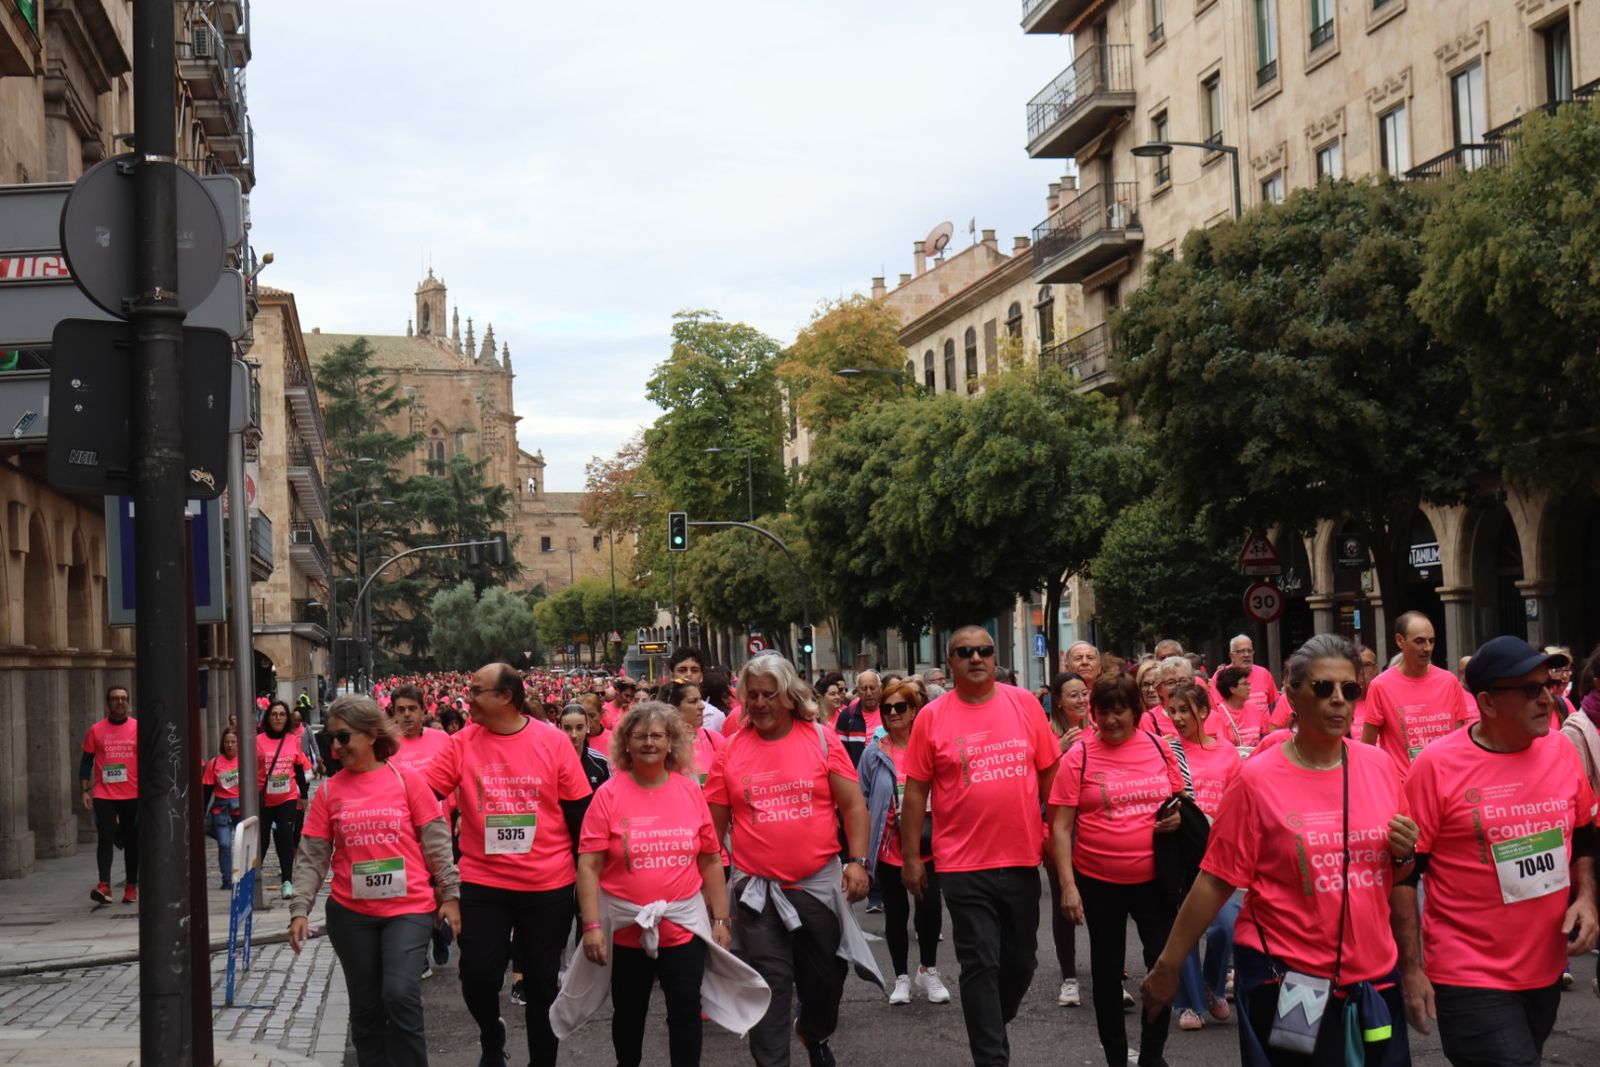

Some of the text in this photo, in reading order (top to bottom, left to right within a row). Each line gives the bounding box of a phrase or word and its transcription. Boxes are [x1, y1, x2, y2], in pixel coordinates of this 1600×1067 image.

[1252, 595, 1275, 609] 30
[1405, 711, 1451, 724] En marcha
[1408, 721, 1450, 735] contra el
[967, 738, 1027, 756] En marcha
[969, 749, 1027, 769] contra el
[483, 775, 542, 785] En marcha
[971, 765, 1027, 783] cáncer
[485, 786, 540, 799] contra el
[751, 778, 814, 796] En marcha
[1107, 781, 1123, 791] En
[753, 791, 812, 809] contra el
[1110, 785, 1172, 804] contra el
[341, 807, 402, 820] En marcha
[485, 798, 541, 813] cáncer
[1113, 801, 1165, 818] cánc
[1483, 797, 1569, 819] En marcha
[757, 805, 813, 823] cáncer
[341, 819, 401, 833] contra el
[630, 826, 694, 839] En marcha
[1487, 814, 1570, 840] contra el
[344, 832, 402, 847] cáncer
[498, 828, 525, 841] 5375
[1306, 826, 1389, 846] En march
[631, 837, 694, 853] contra el
[632, 853, 694, 869] cáncer
[1311, 848, 1376, 869] contra
[1515, 852, 1555, 878] 7040
[366, 873, 393, 887] 5377
[1314, 867, 1384, 893] cánce
